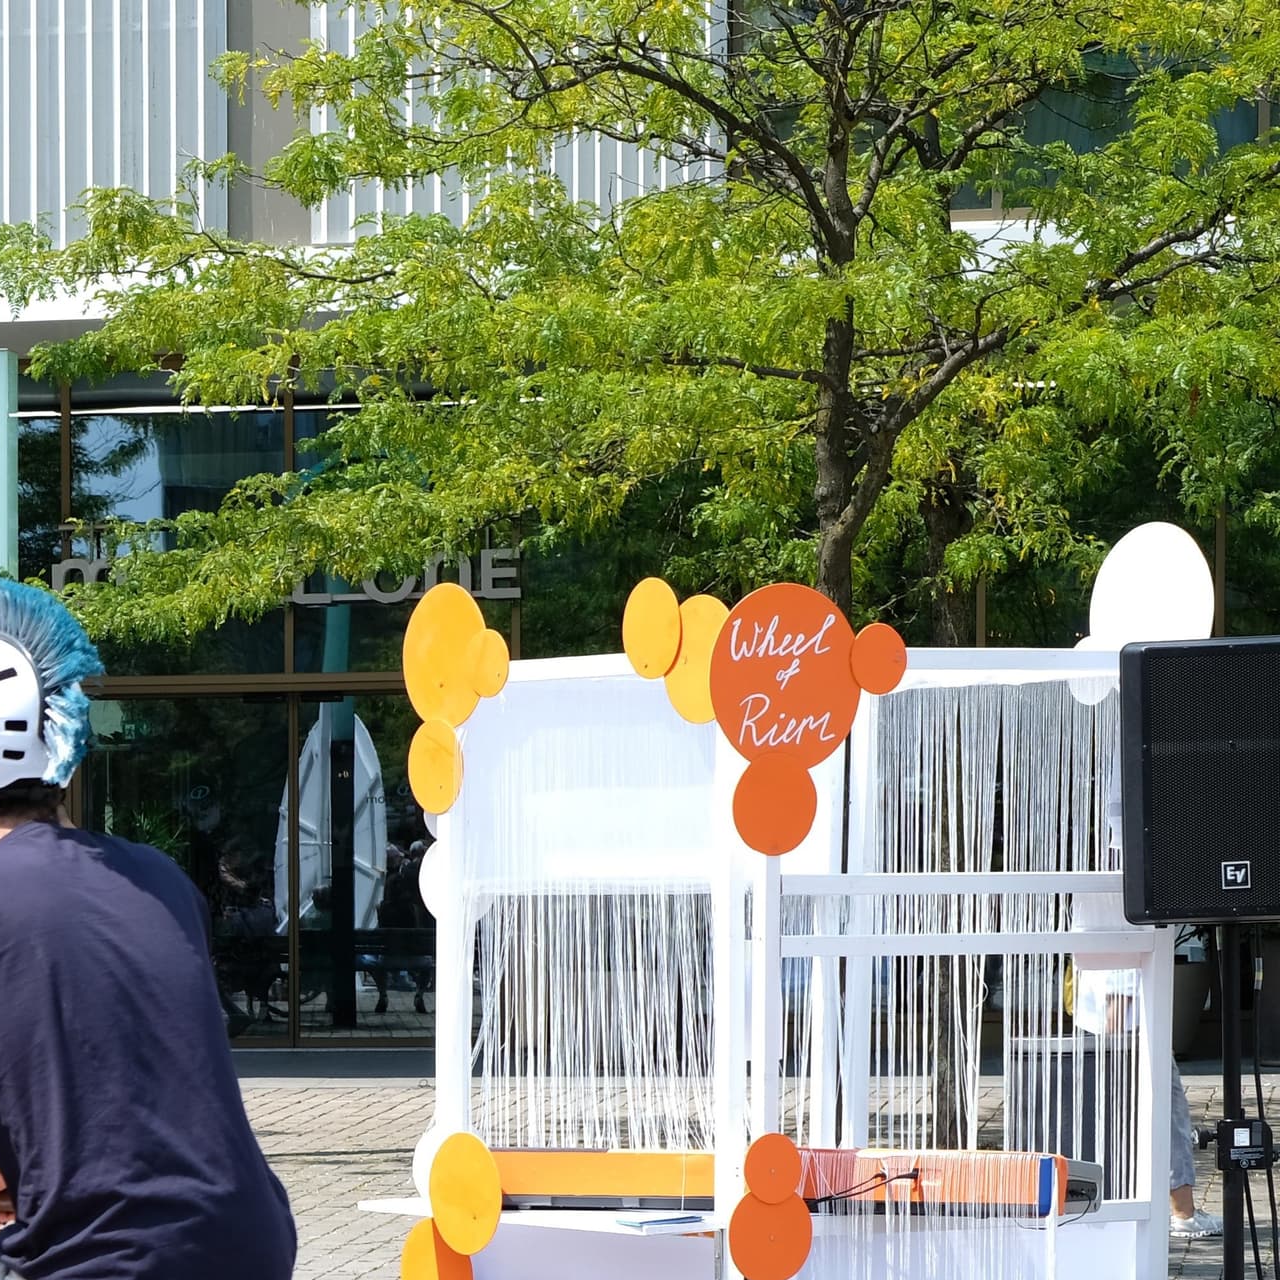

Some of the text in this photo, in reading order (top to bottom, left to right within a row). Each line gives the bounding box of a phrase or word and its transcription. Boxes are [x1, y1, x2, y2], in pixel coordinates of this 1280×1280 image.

[730, 614, 836, 661] Wheel
[776, 658, 800, 690] of
[739, 693, 836, 746] Riem
